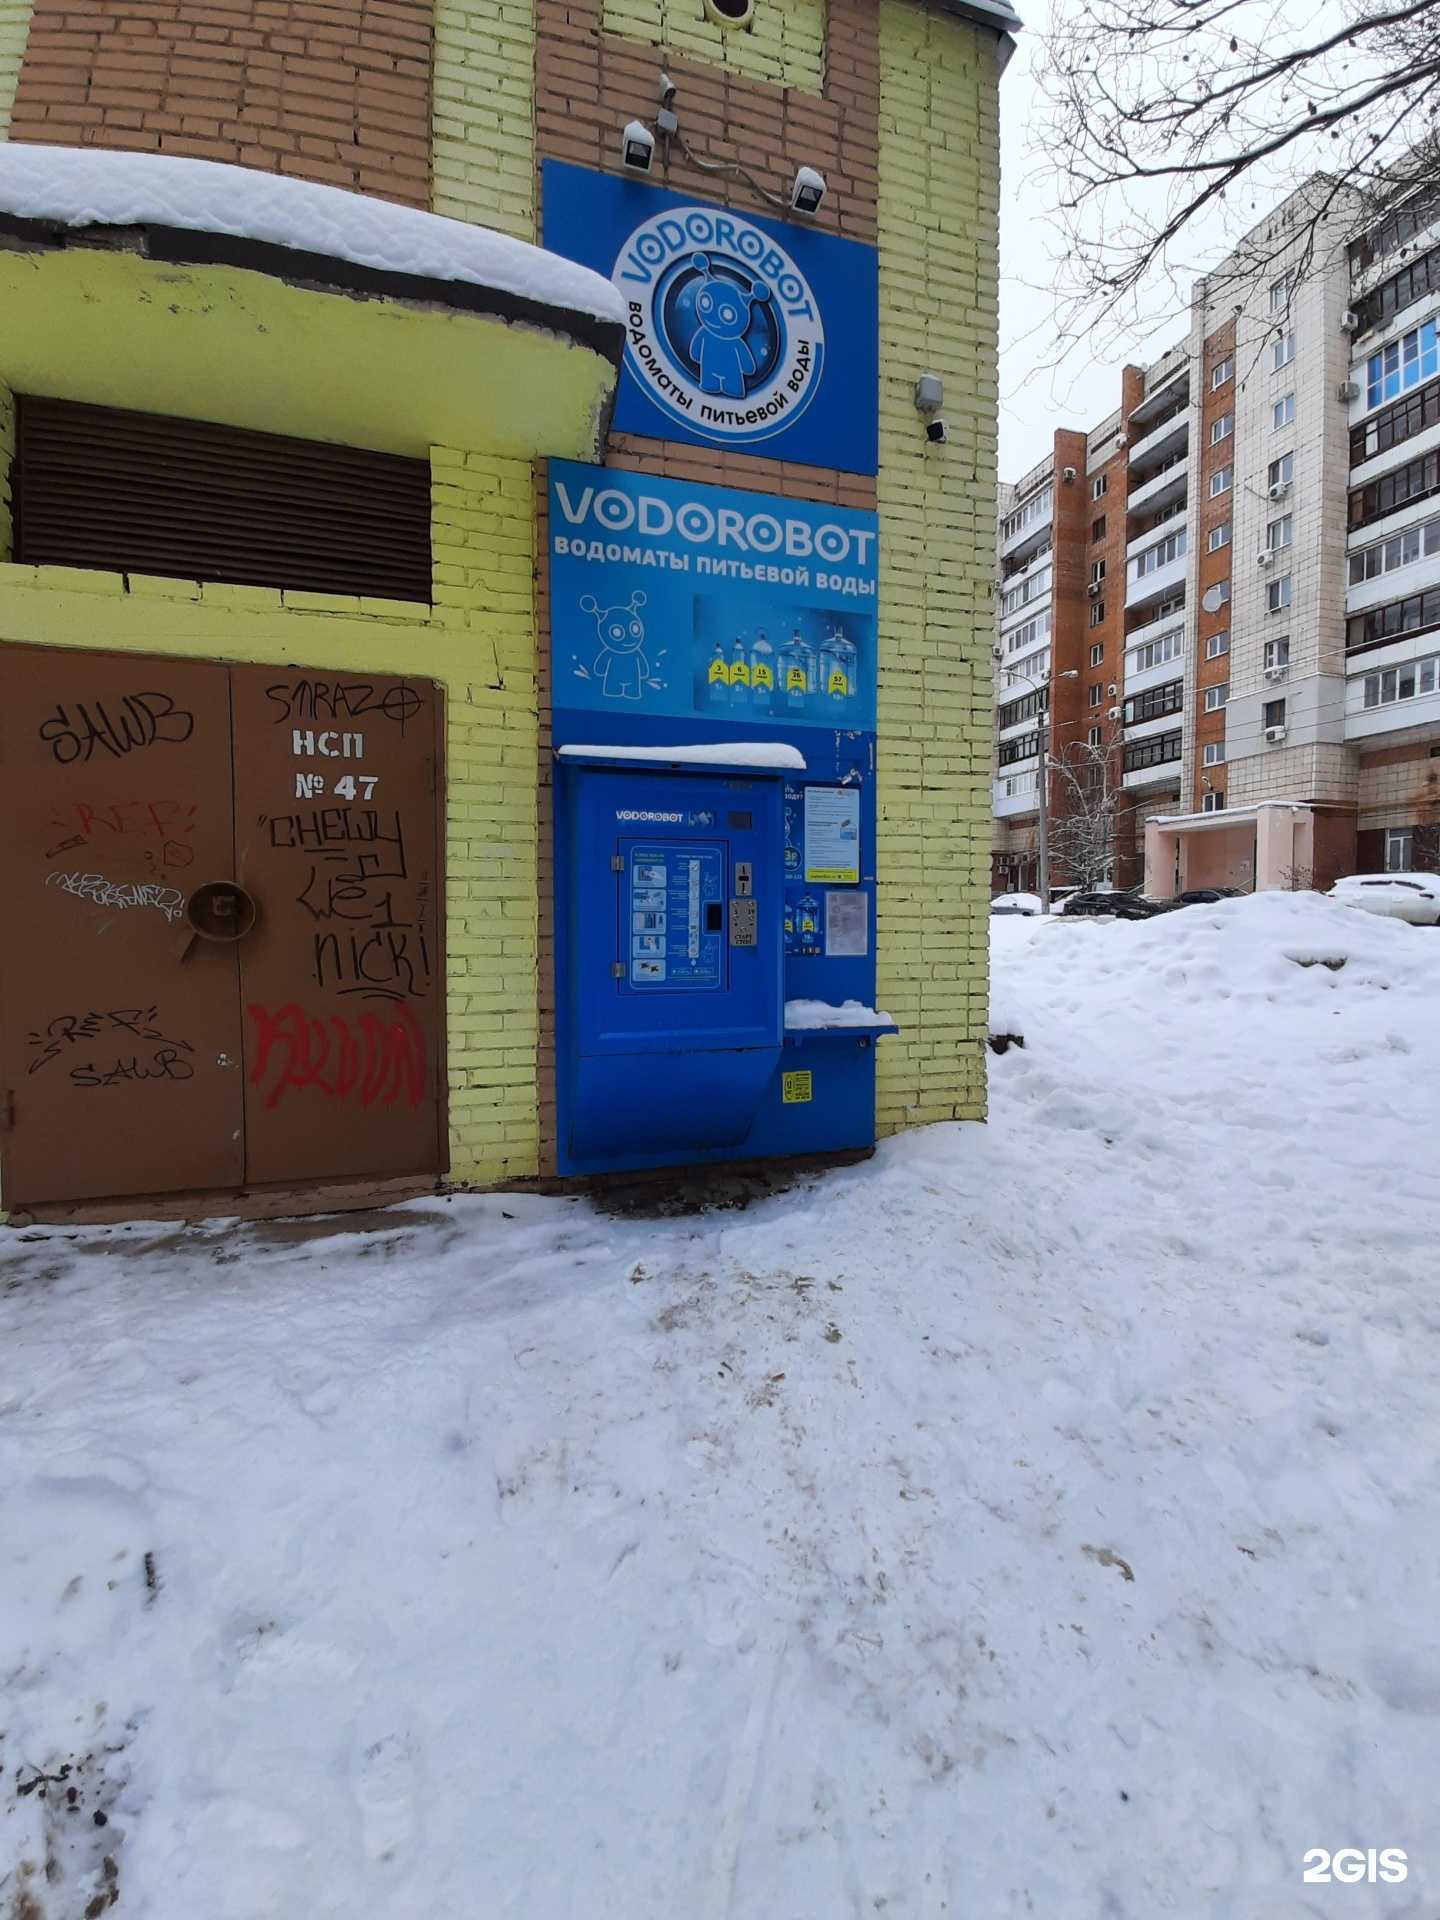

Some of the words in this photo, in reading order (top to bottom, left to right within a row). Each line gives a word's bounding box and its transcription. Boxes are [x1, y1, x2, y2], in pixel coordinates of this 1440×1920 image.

[622, 212, 814, 323] VODOROBOT
[554, 481, 876, 566] VODOROBOT
[554, 536, 690, 571] ВОДОМАТЫ
[696, 555, 810, 588] ПИТЬЕВОЙ
[815, 571, 876, 597] ВОДЫ
[292, 729, 365, 759] НСП
[295, 772, 325, 801] №
[333, 775, 379, 801] 47
[616, 810, 684, 823] VODOROBOT
